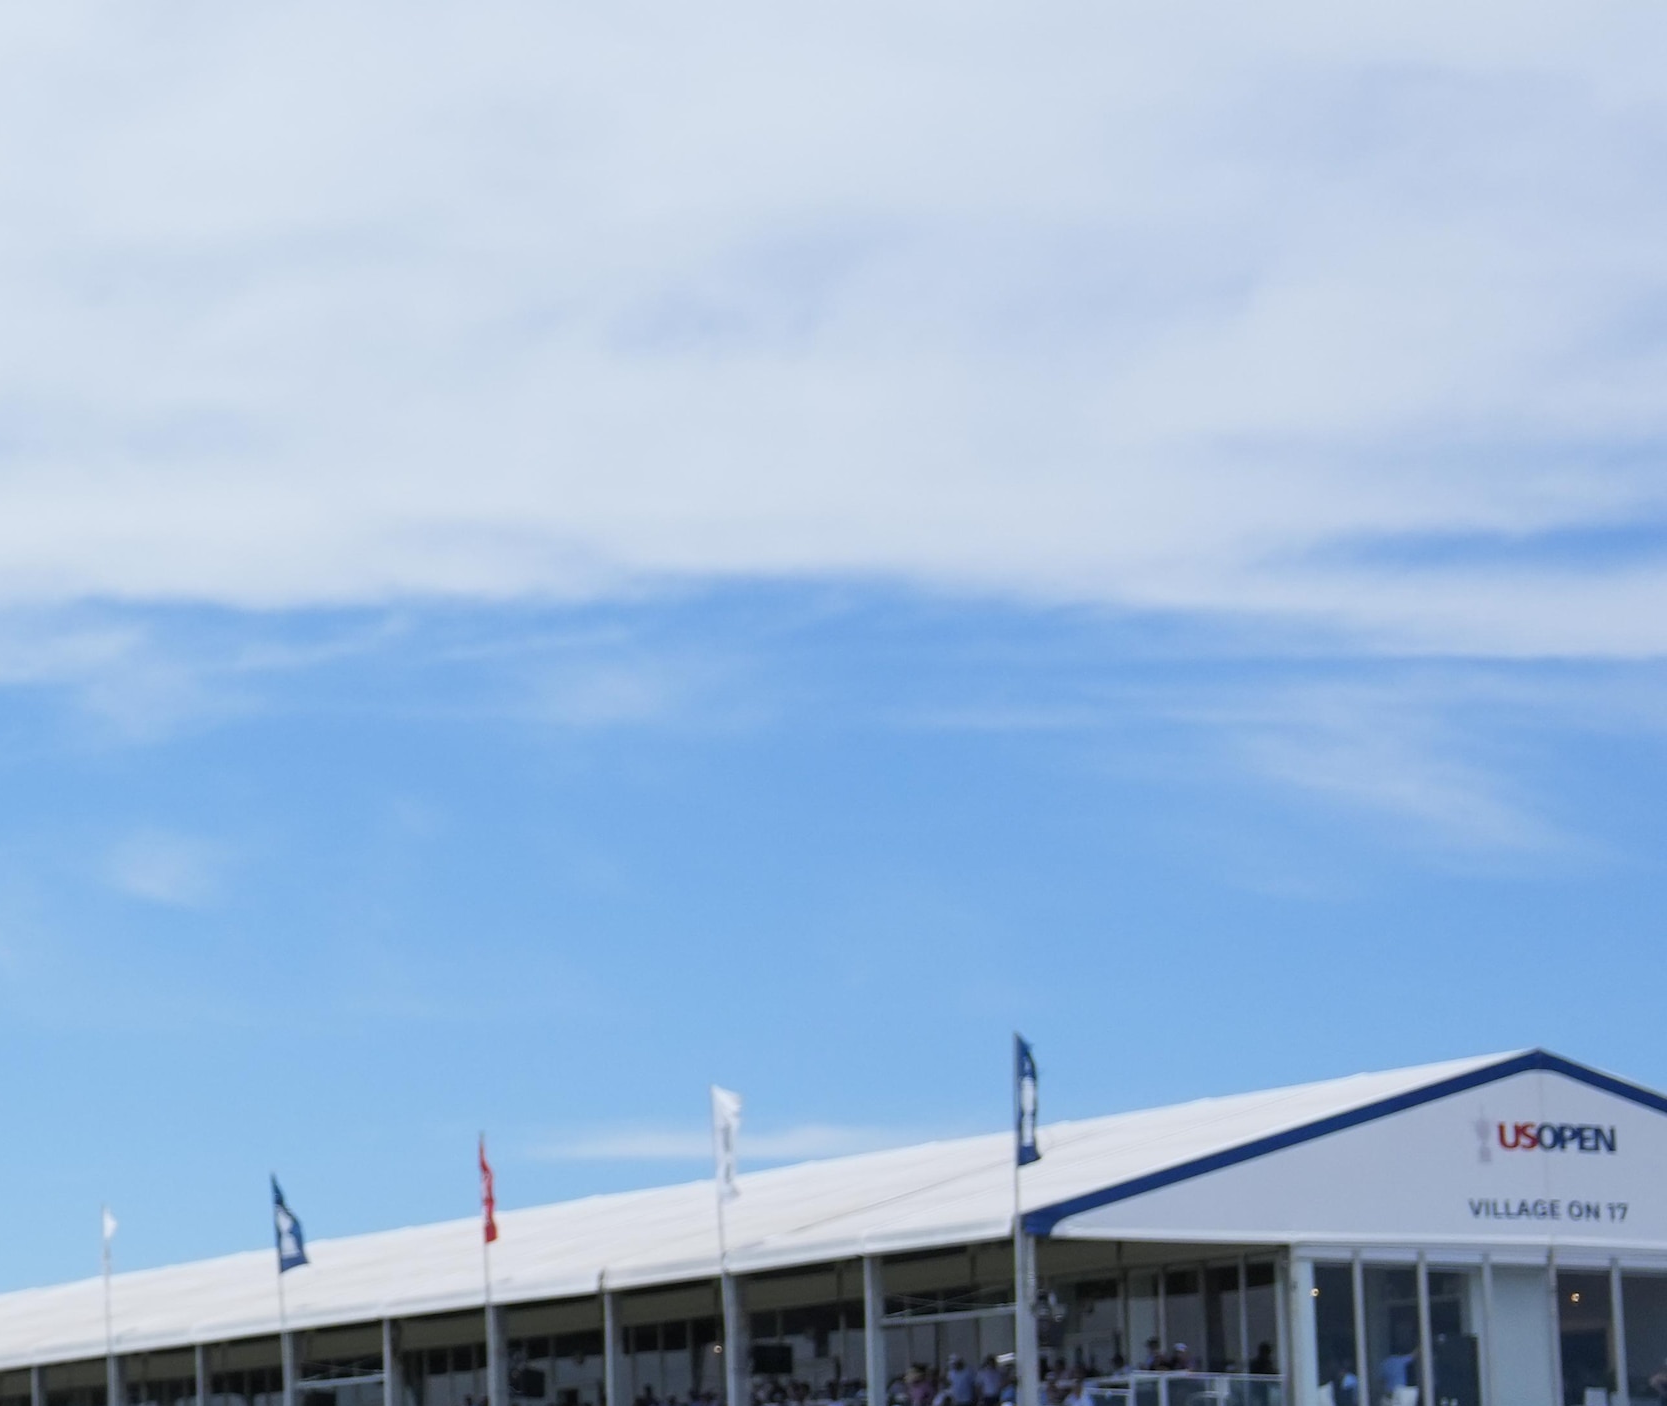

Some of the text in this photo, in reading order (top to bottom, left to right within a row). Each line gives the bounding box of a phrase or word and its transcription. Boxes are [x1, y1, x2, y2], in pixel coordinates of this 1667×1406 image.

[1469, 1199, 1628, 1222] VILLAGE ON 17
